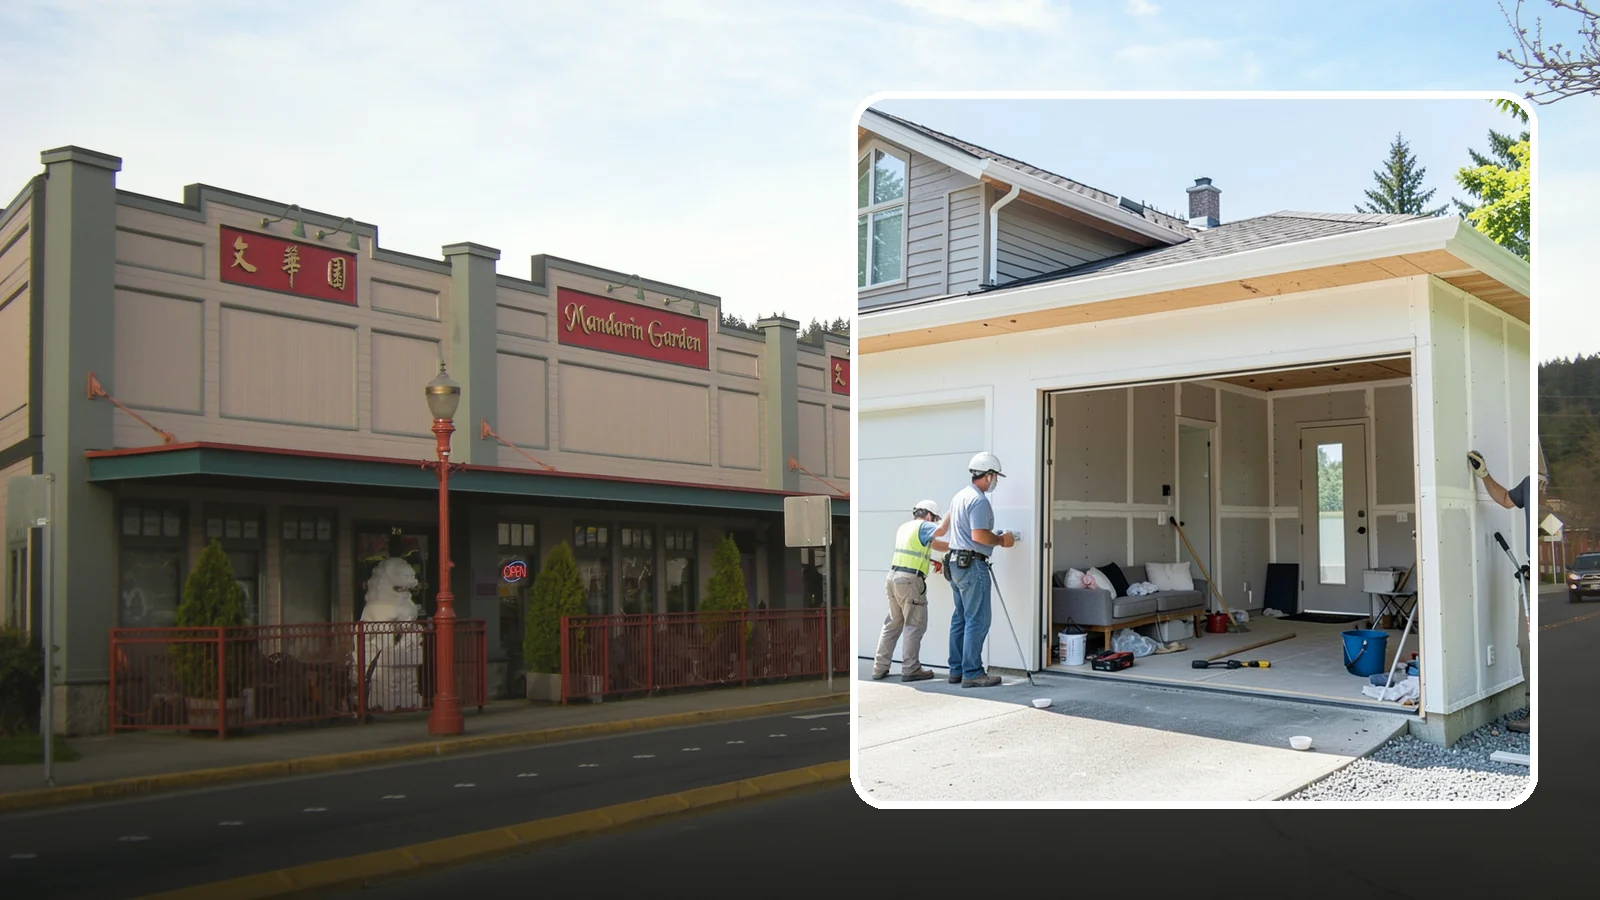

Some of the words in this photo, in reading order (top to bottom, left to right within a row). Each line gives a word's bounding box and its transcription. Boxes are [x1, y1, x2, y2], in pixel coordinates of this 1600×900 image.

[565, 303, 644, 341] Mandarin
[648, 320, 701, 352] Garden
[503, 565, 527, 578] OPEN
